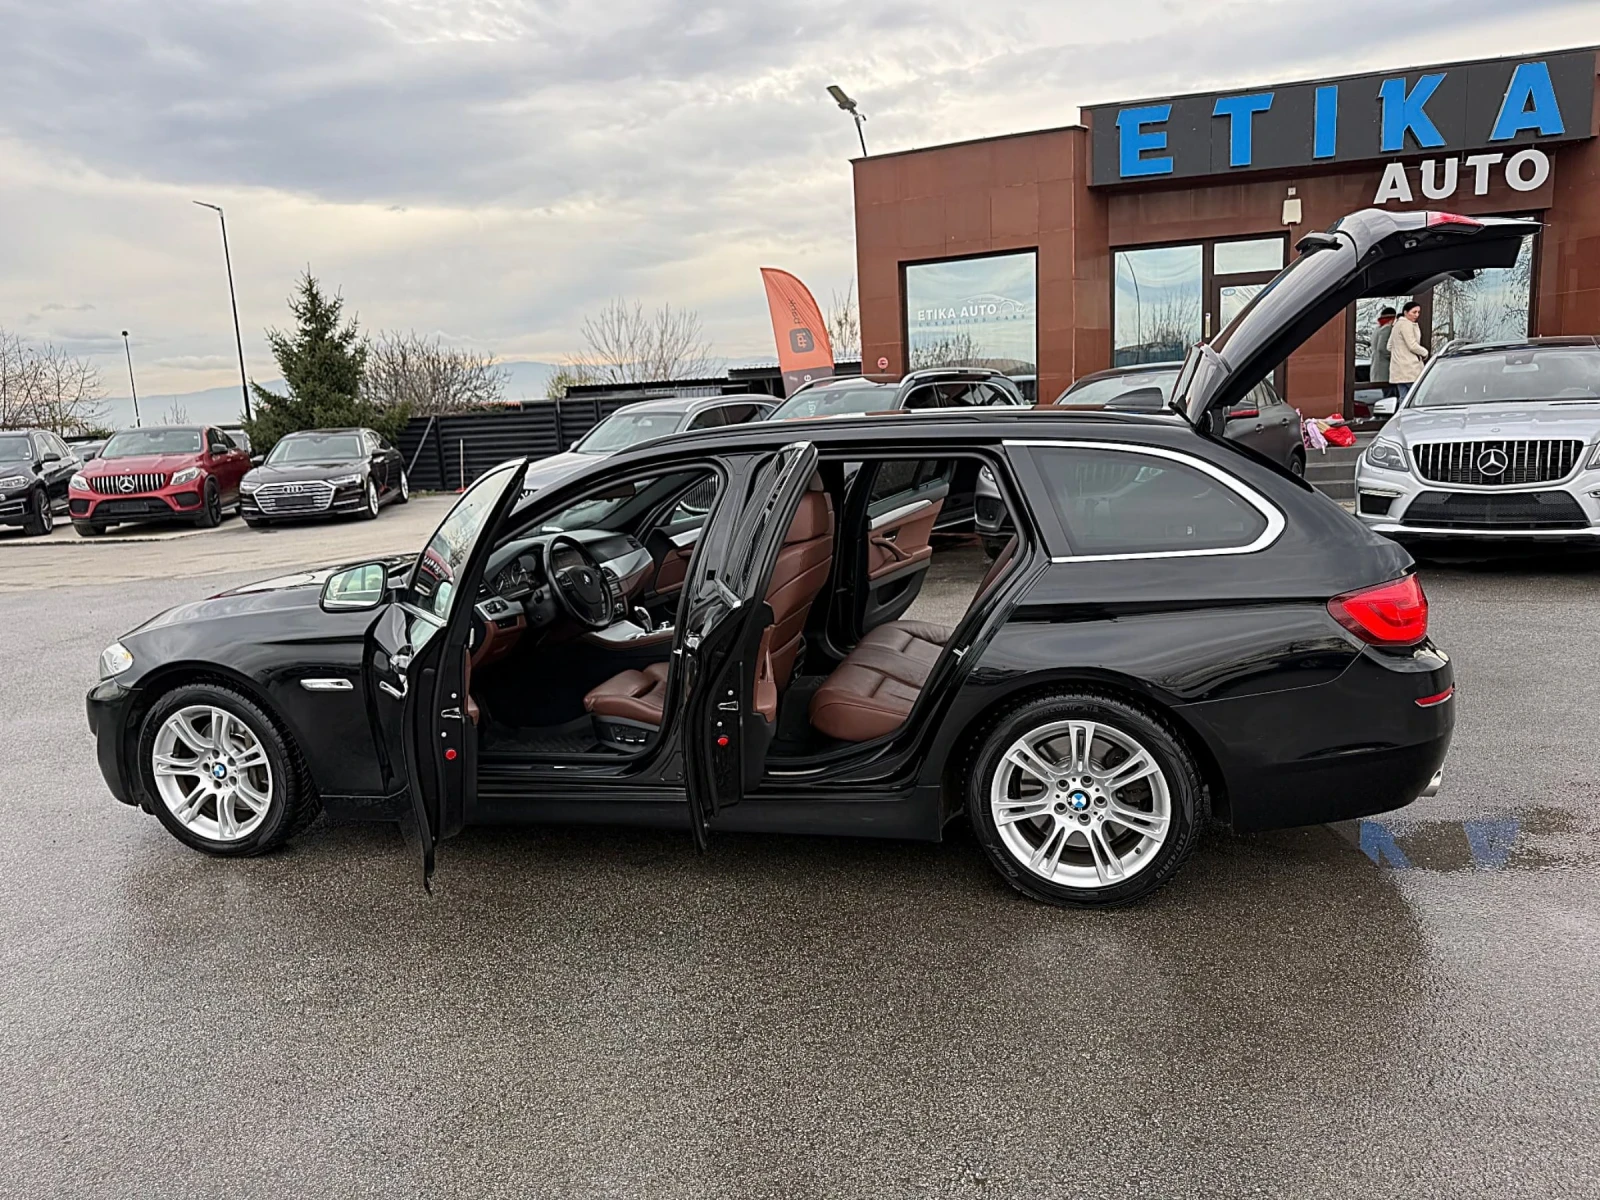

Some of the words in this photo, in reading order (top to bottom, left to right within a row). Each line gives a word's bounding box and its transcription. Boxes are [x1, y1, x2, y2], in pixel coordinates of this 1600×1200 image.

[1115, 61, 1566, 178] ETIKA
[1373, 149, 1550, 204] AUTO
[917, 307, 956, 321] ETIKA
[960, 303, 997, 317] AUTO
